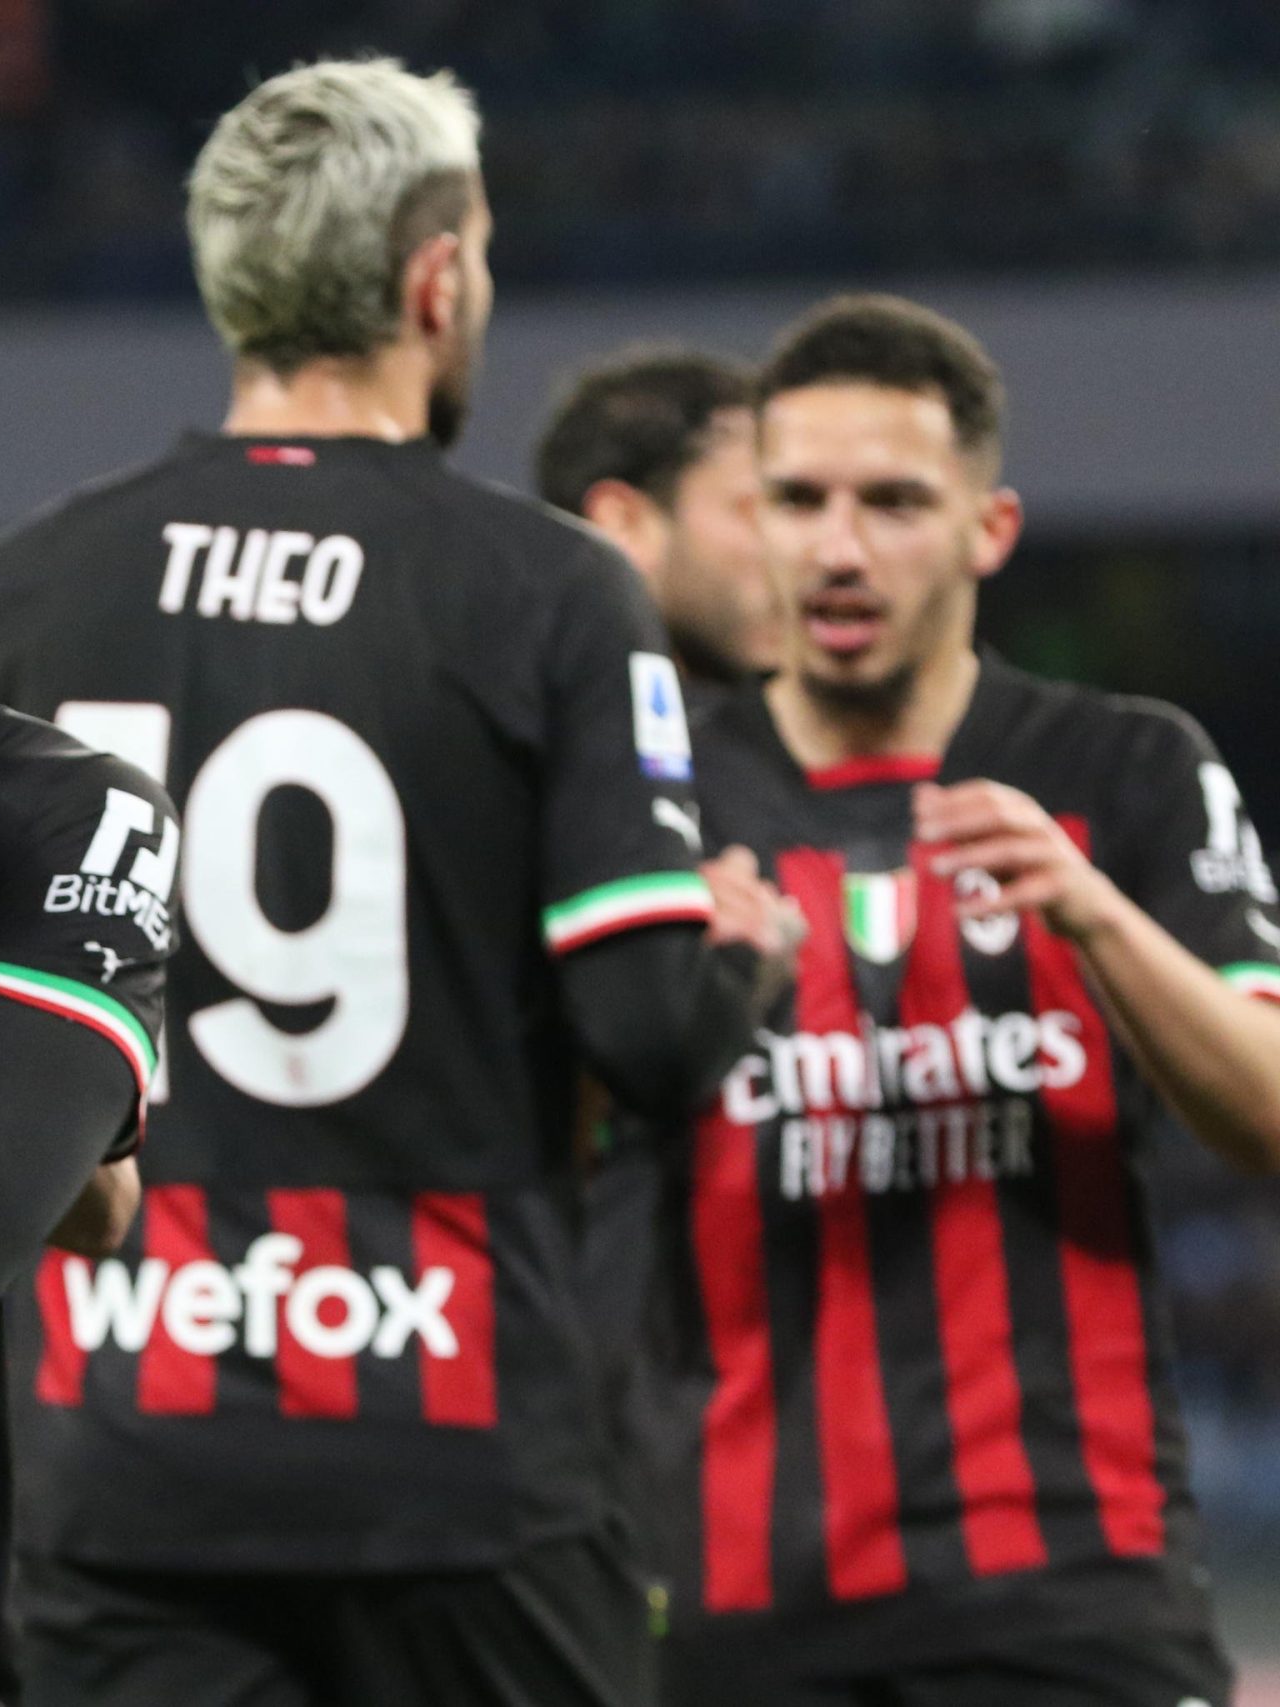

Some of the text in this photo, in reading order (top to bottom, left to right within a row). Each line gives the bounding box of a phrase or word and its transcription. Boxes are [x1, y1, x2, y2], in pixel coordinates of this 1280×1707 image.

[159, 523, 363, 627] THEO
[43, 873, 173, 951] BitME
[62, 1232, 459, 1359] wefox
